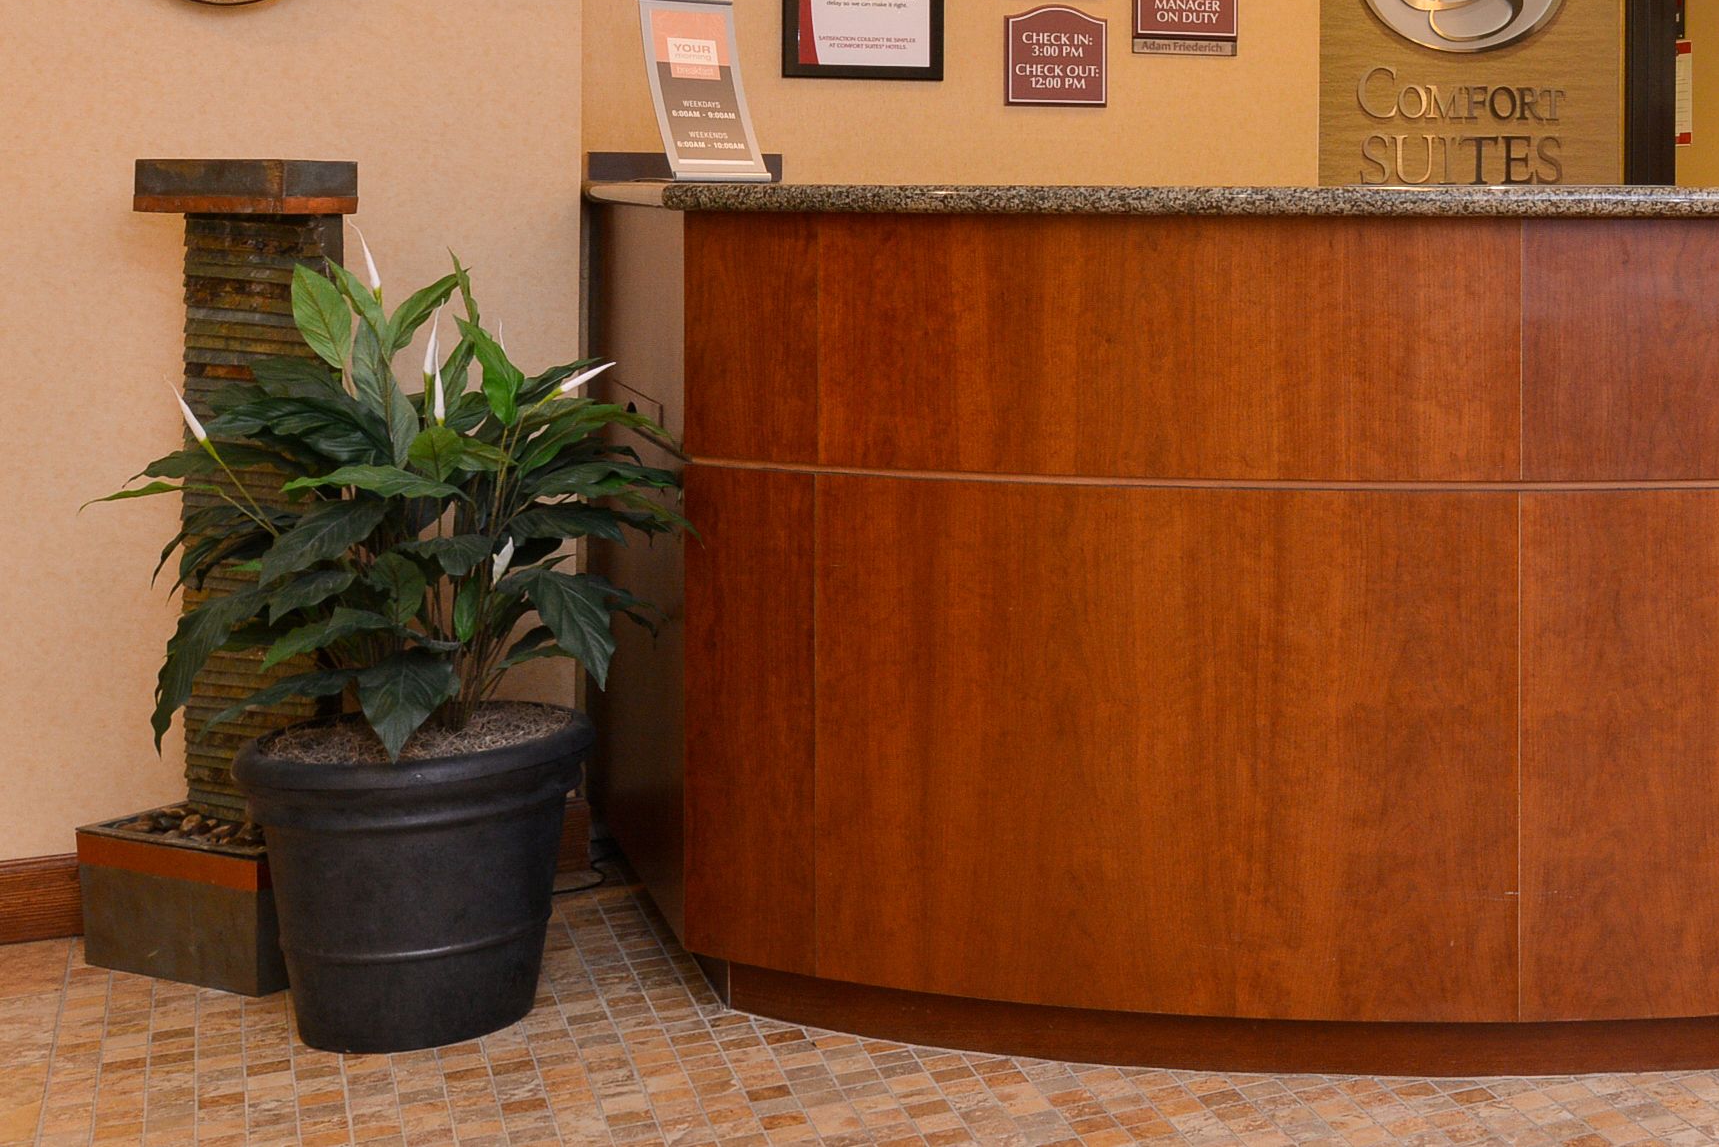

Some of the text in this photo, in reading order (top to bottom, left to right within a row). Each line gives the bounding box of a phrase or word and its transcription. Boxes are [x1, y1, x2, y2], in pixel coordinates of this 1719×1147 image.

[1156, 11, 1219, 23] ON DUTY
[1022, 32, 1093, 45] CHECK IN:
[674, 43, 711, 54] YOUR
[1032, 45, 1084, 57] 3:00 PM
[1142, 41, 1222, 53] Adam Friederich
[675, 54, 712, 62] morning
[1015, 64, 1099, 77] CHECK OUT:
[1030, 77, 1086, 89] 12:00 PM
[1357, 67, 1566, 122] COMFORT
[683, 100, 721, 109] WEEKDAYS
[672, 109, 700, 118] 6:00AM
[708, 111, 736, 120] 9:00AM
[688, 131, 728, 139] WEEKENDS
[677, 140, 706, 149] 6:00AM
[714, 141, 745, 150] 10:00AM
[1360, 134, 1563, 185] SUITES
